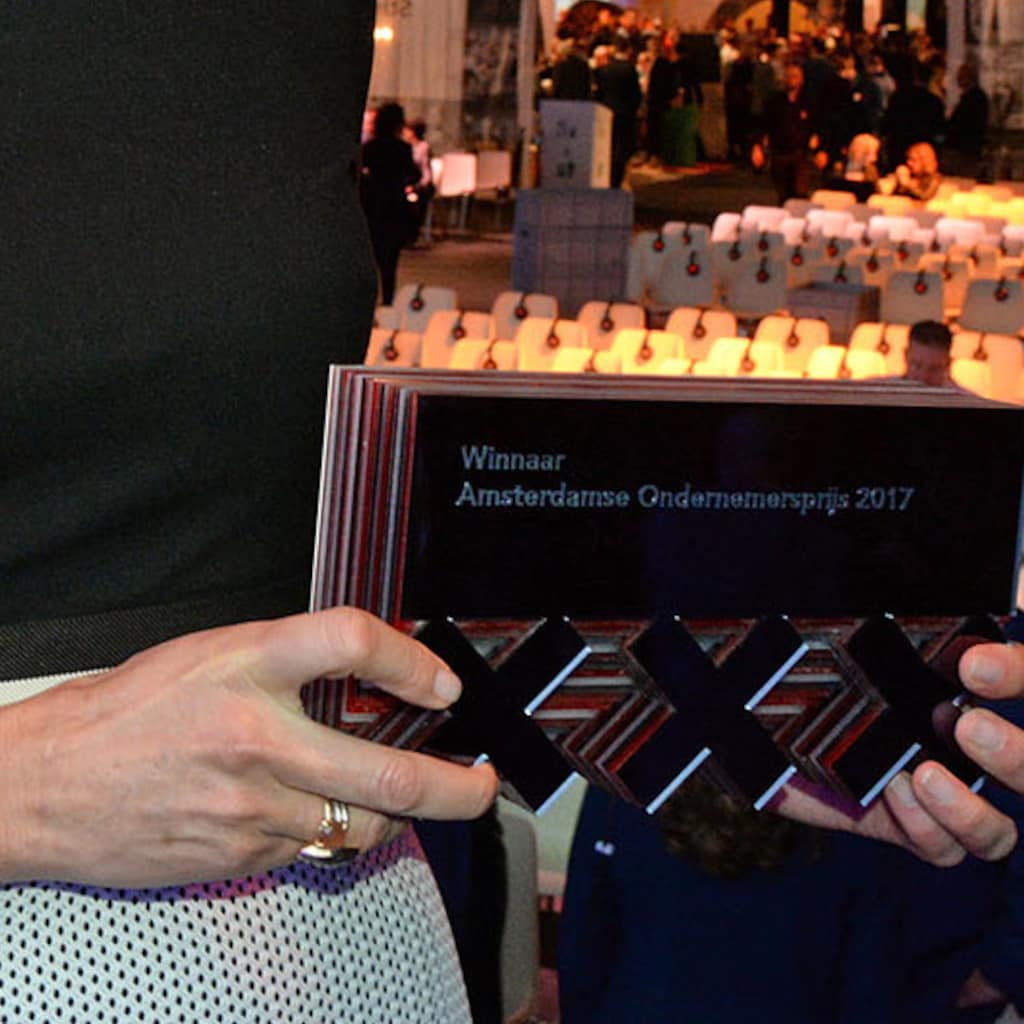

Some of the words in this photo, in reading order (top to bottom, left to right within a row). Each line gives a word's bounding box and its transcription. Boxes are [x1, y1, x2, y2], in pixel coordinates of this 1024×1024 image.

[461, 444, 566, 471] Winnaar
[454, 480, 630, 507] Amsterdamse
[637, 482, 849, 516] Ondernemersprijs
[855, 487, 914, 510] 2017
